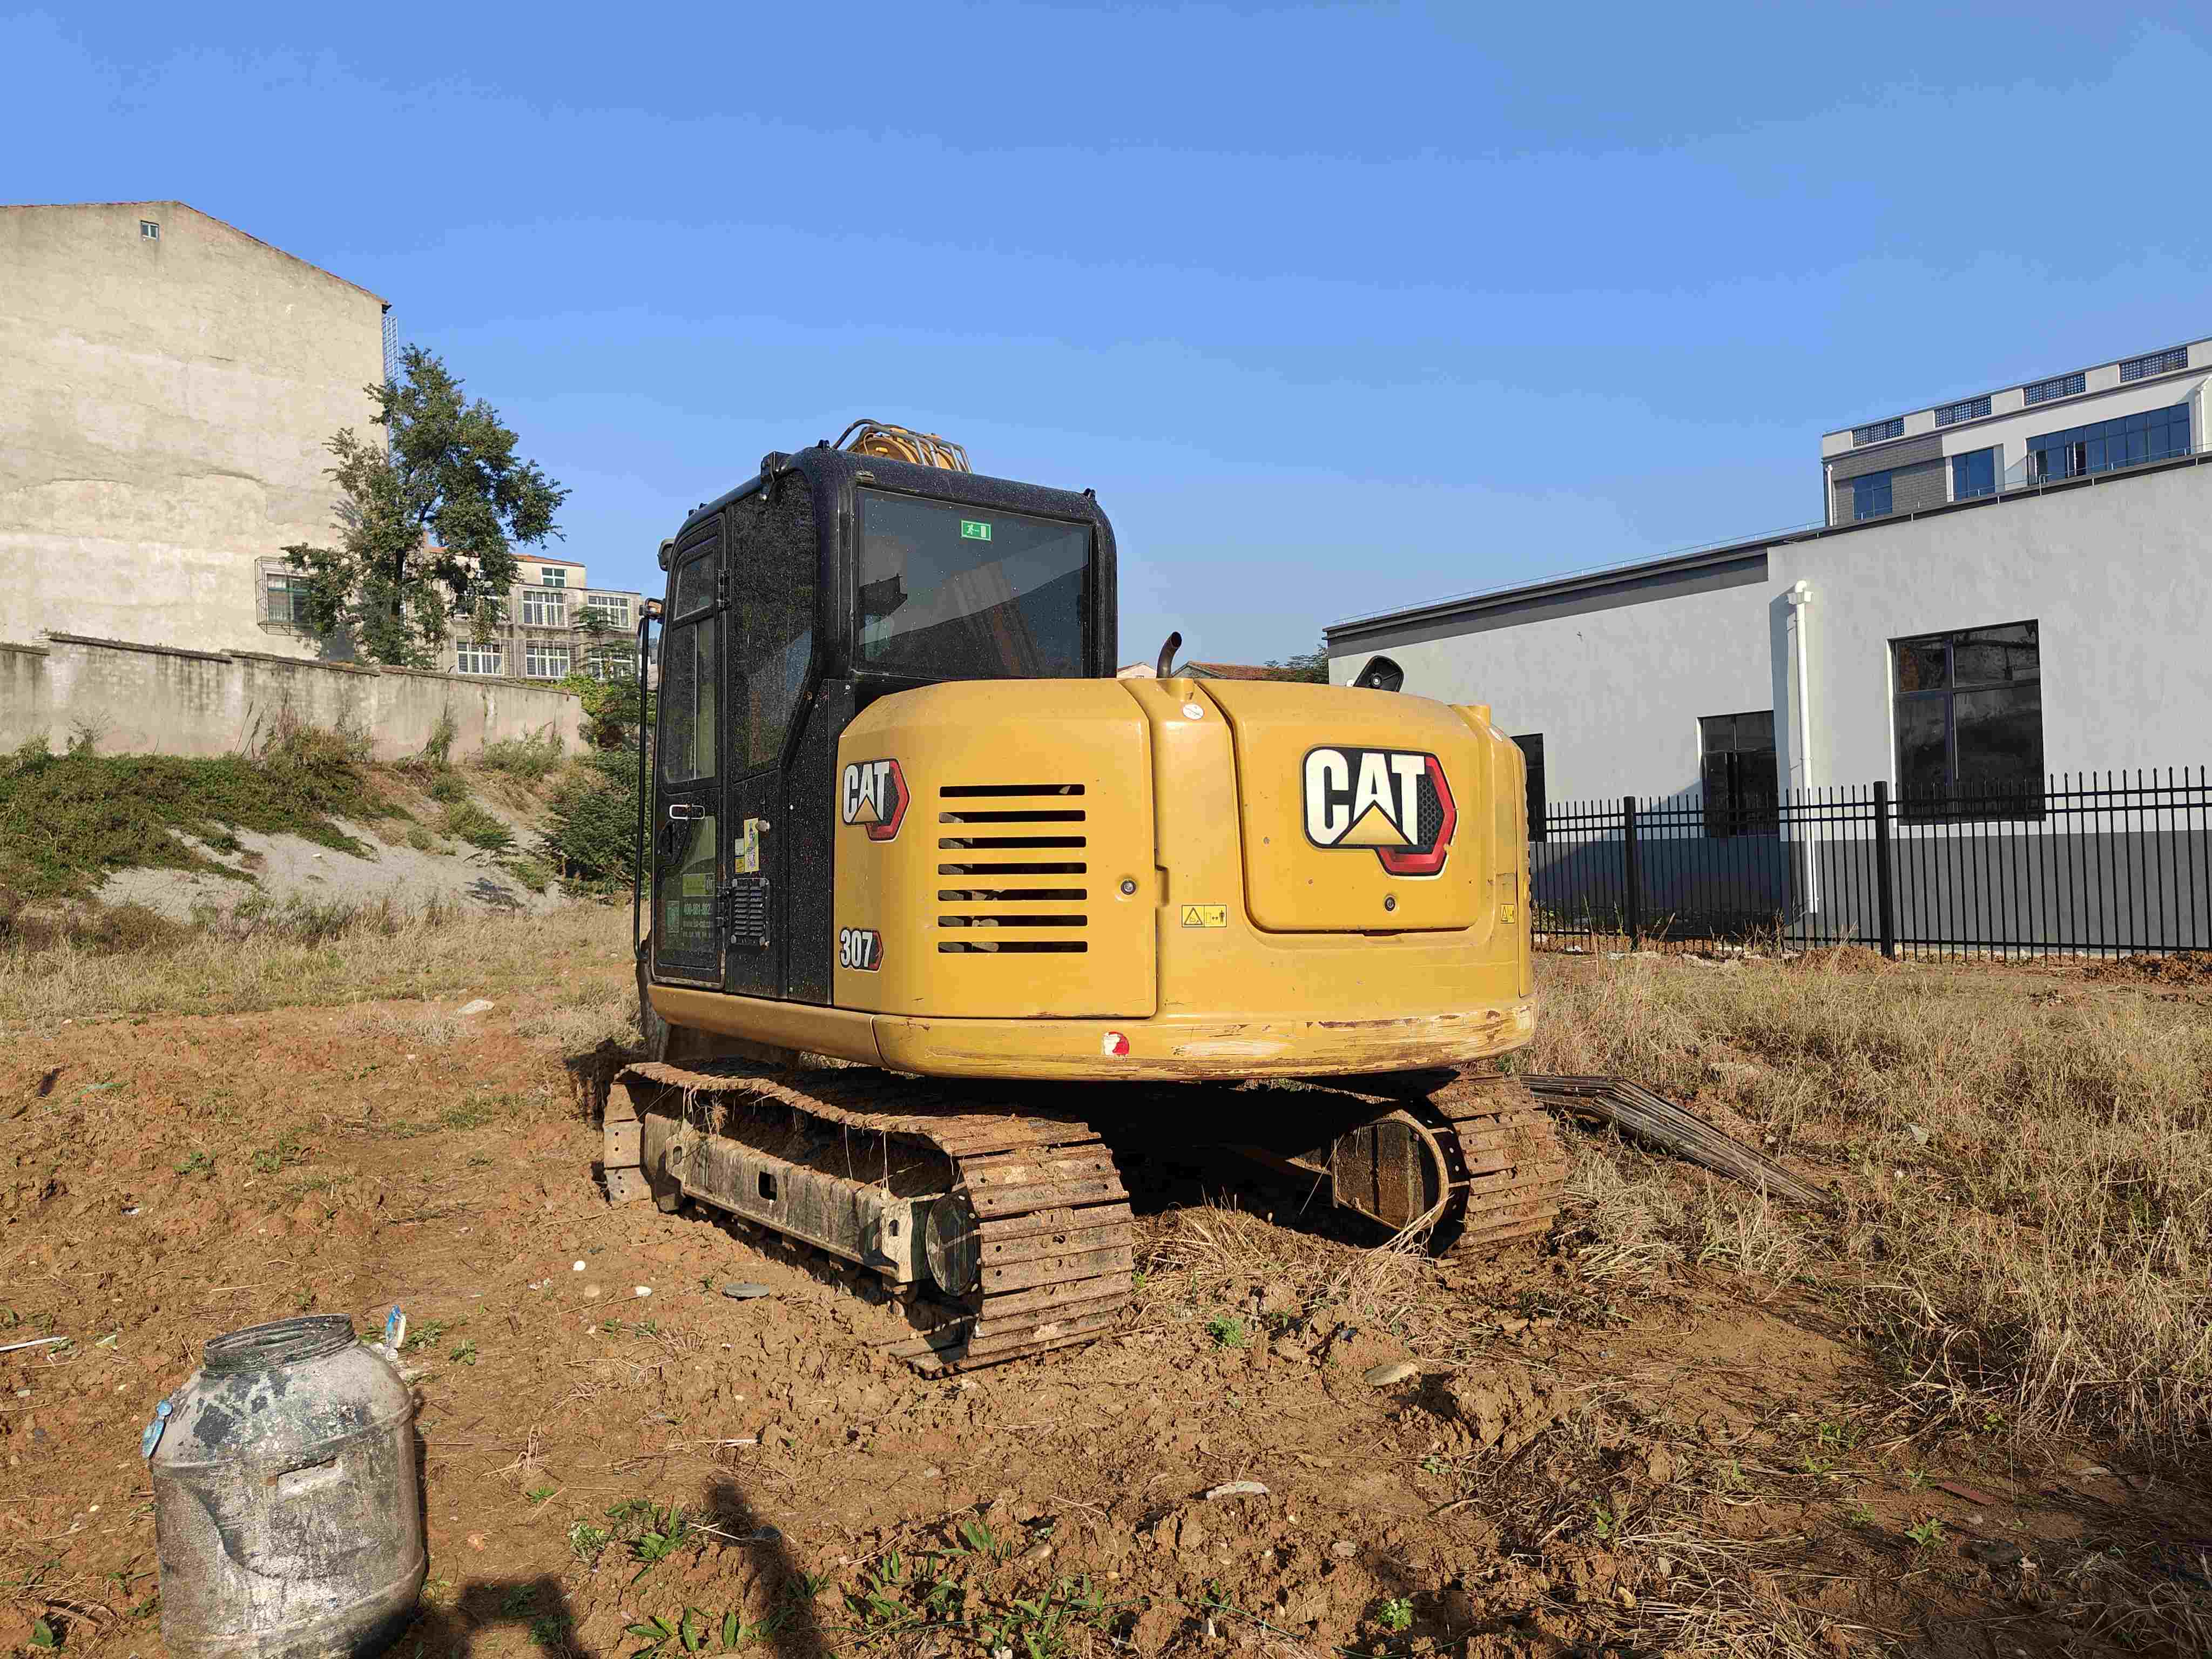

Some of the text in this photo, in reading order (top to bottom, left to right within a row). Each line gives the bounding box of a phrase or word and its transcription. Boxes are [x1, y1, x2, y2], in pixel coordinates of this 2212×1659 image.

[843, 761, 890, 823] CAT
[1305, 749, 1425, 845] CAT
[840, 929, 873, 967] 307
